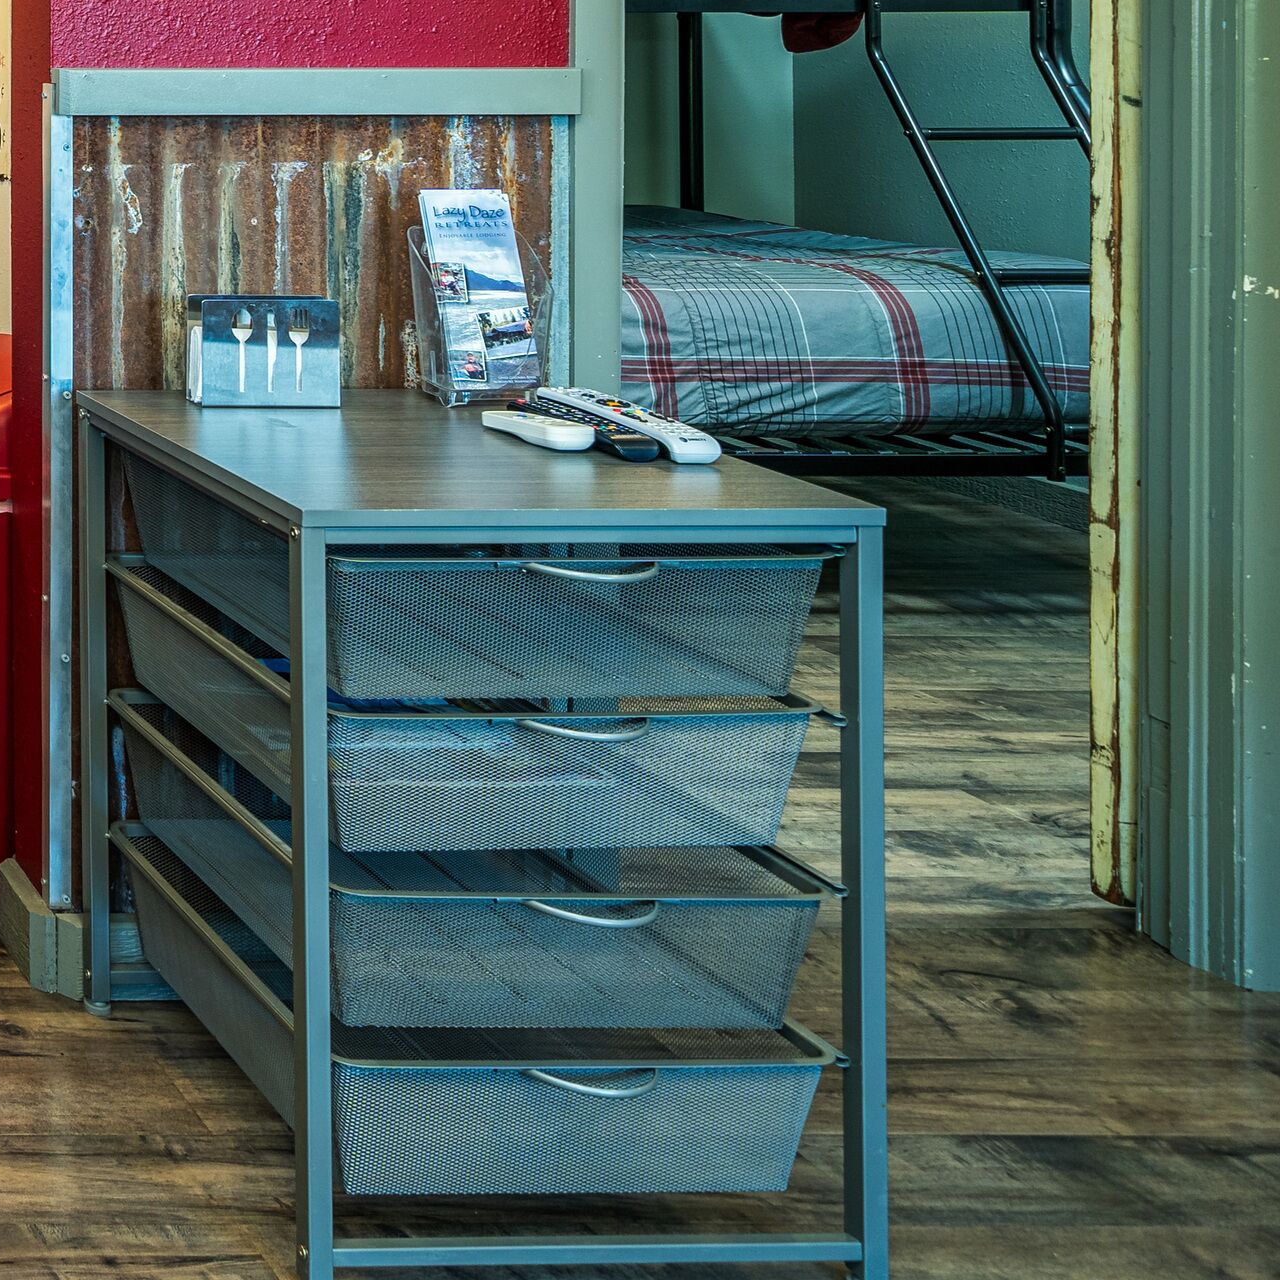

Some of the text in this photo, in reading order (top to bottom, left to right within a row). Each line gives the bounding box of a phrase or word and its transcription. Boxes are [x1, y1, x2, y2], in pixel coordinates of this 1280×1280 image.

[432, 205, 505, 222] Lazy Daze
[435, 221, 508, 229] RETREATS
